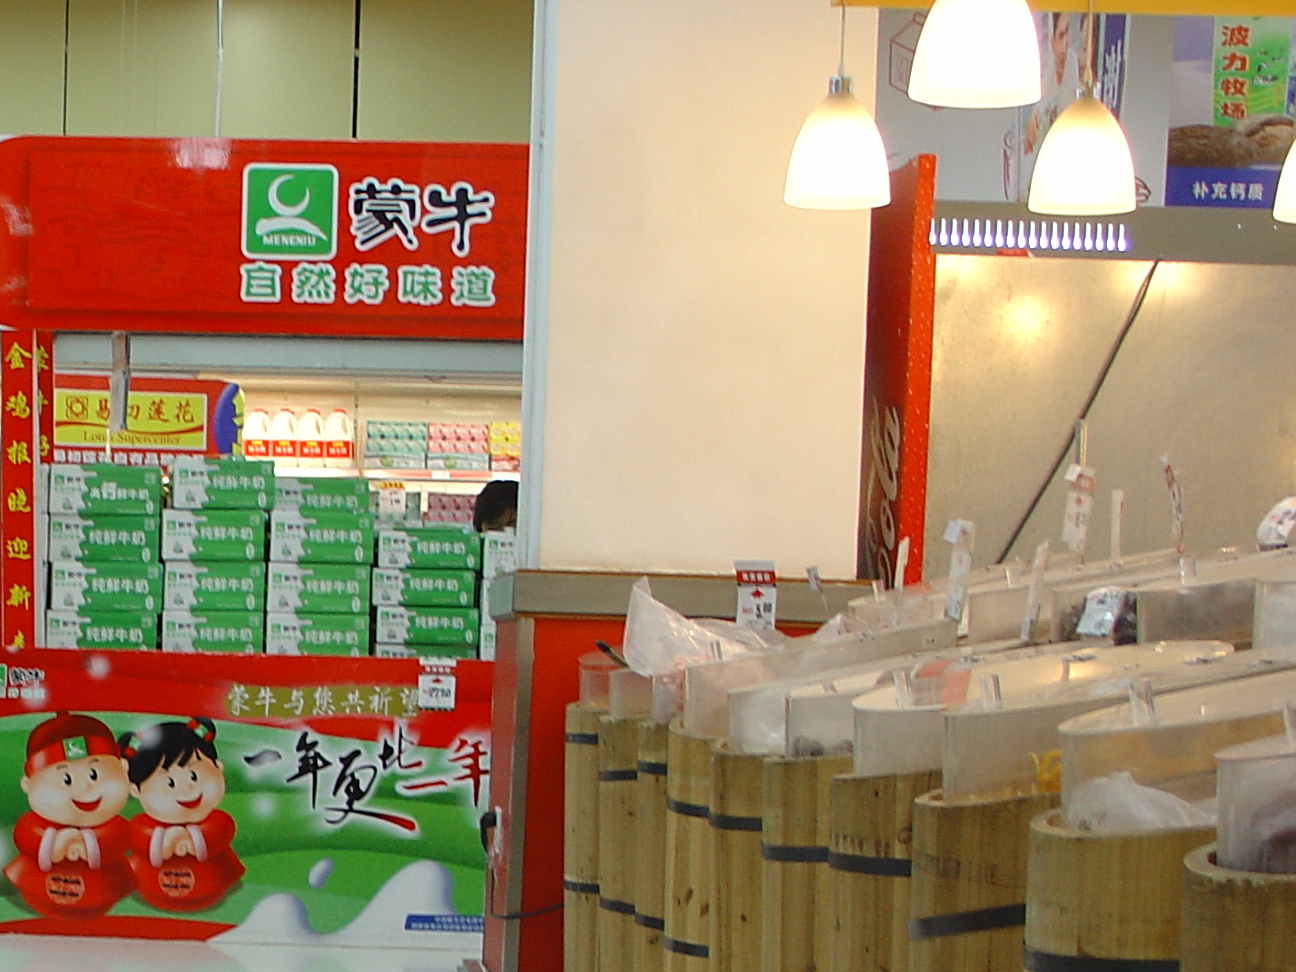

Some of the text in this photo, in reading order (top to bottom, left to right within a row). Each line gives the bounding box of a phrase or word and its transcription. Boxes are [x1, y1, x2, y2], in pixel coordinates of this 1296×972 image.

[351, 178, 494, 256] 蒙牛
[241, 262, 495, 306] 自然好味道
